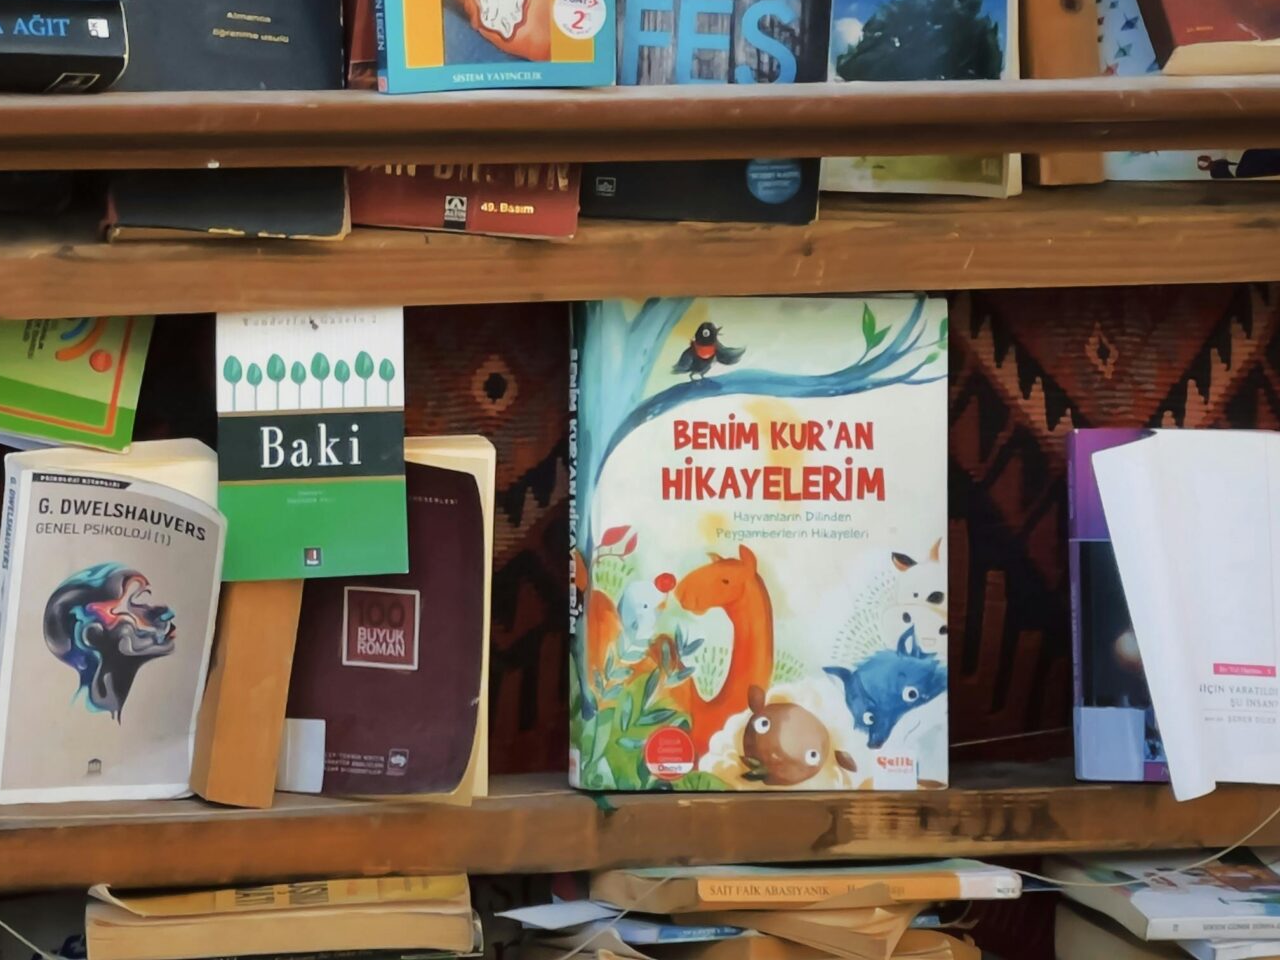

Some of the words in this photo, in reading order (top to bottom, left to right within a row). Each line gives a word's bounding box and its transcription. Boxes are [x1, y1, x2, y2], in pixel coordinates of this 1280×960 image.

[14, 10, 70, 38] AĞIT
[572, 10, 584, 29] 2
[481, 202, 497, 212] 49.
[674, 413, 759, 451] BENİM
[770, 419, 874, 451] KUR'AN
[260, 424, 361, 468] Baki
[661, 457, 886, 501] HİKAYELERİM
[39, 498, 53, 514] G.
[61, 498, 206, 541] DWELSHAUVERS
[733, 511, 802, 524] Hayvanların
[806, 511, 852, 523] Dilinden
[36, 523, 79, 535] GENEL
[83, 524, 151, 540] PSİKOLOJİ
[716, 527, 808, 540] Peygamberlerin
[811, 528, 869, 539] Hikayeleri
[357, 642, 405, 657] ROMAN
[710, 884, 733, 896] SAİT
[736, 885, 762, 896] FAİK
[765, 885, 831, 896] ABASIYANIK
